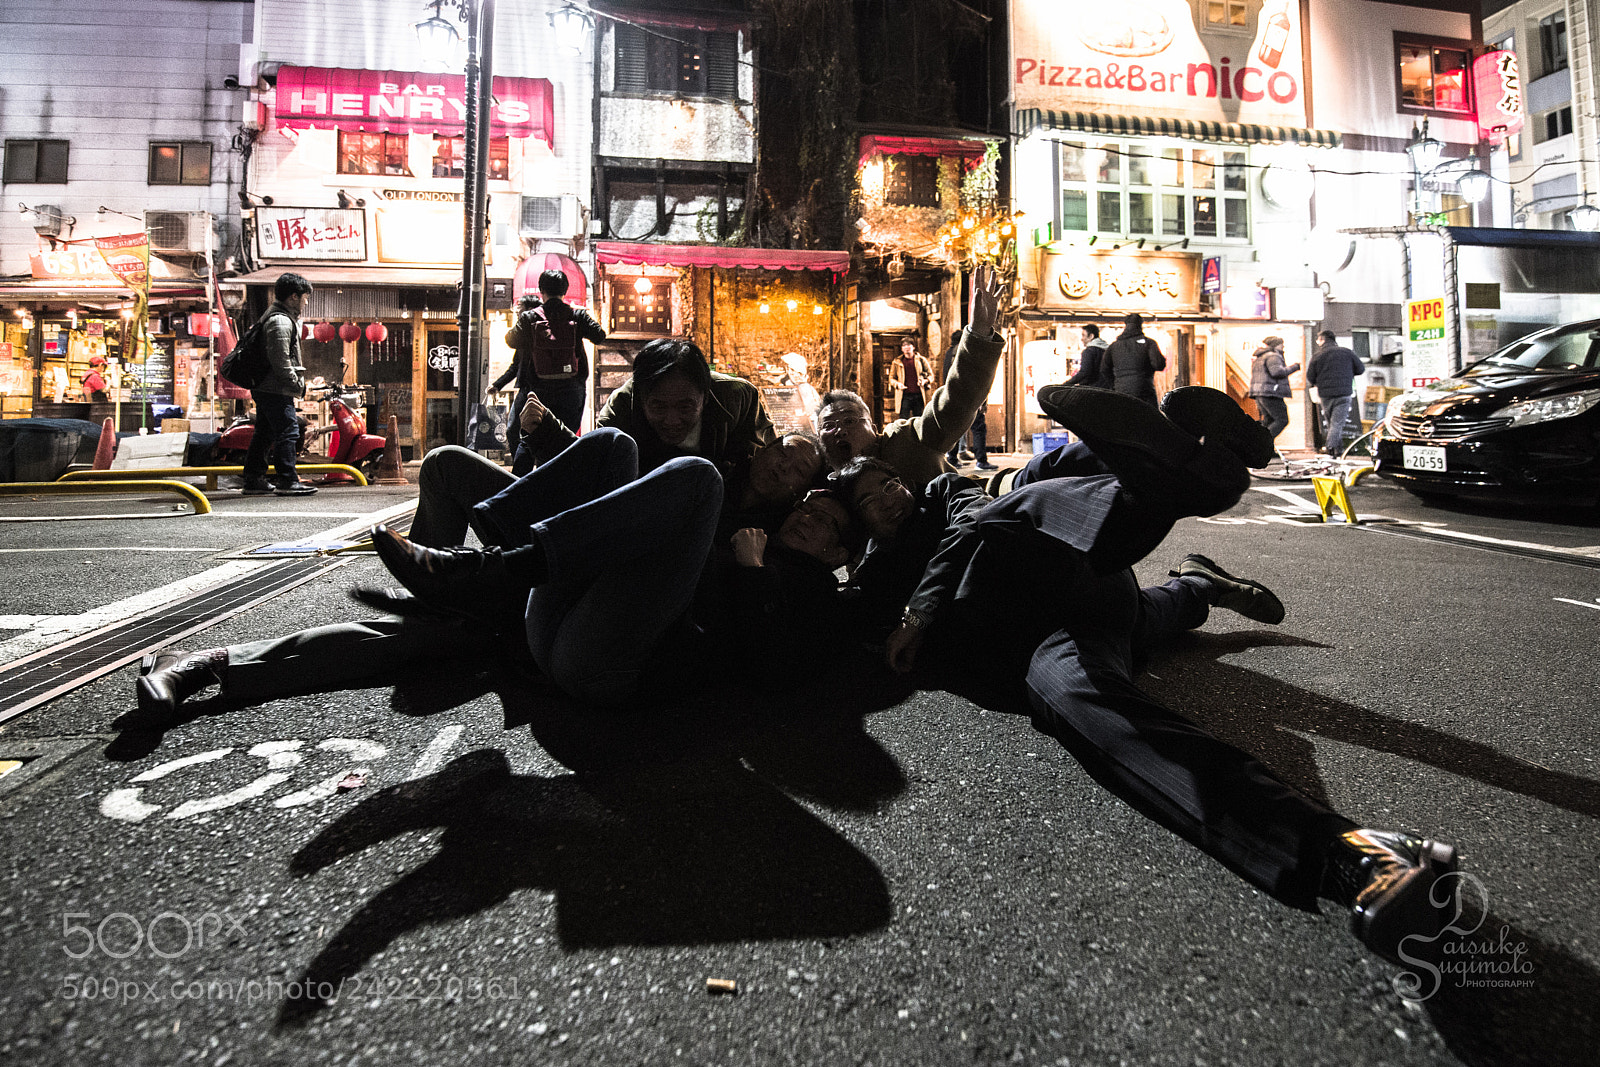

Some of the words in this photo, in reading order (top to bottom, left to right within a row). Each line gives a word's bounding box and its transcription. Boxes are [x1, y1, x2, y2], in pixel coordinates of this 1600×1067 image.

[1016, 57, 1184, 93] Pizza&Bar
[1186, 56, 1298, 105] nico
[379, 82, 446, 96] BAR
[385, 190, 406, 200] OLD
[411, 191, 454, 202] LONDON
[1411, 301, 1442, 322] NPC
[1416, 328, 1440, 341] 24H
[1412, 455, 1444, 470] 20-59
